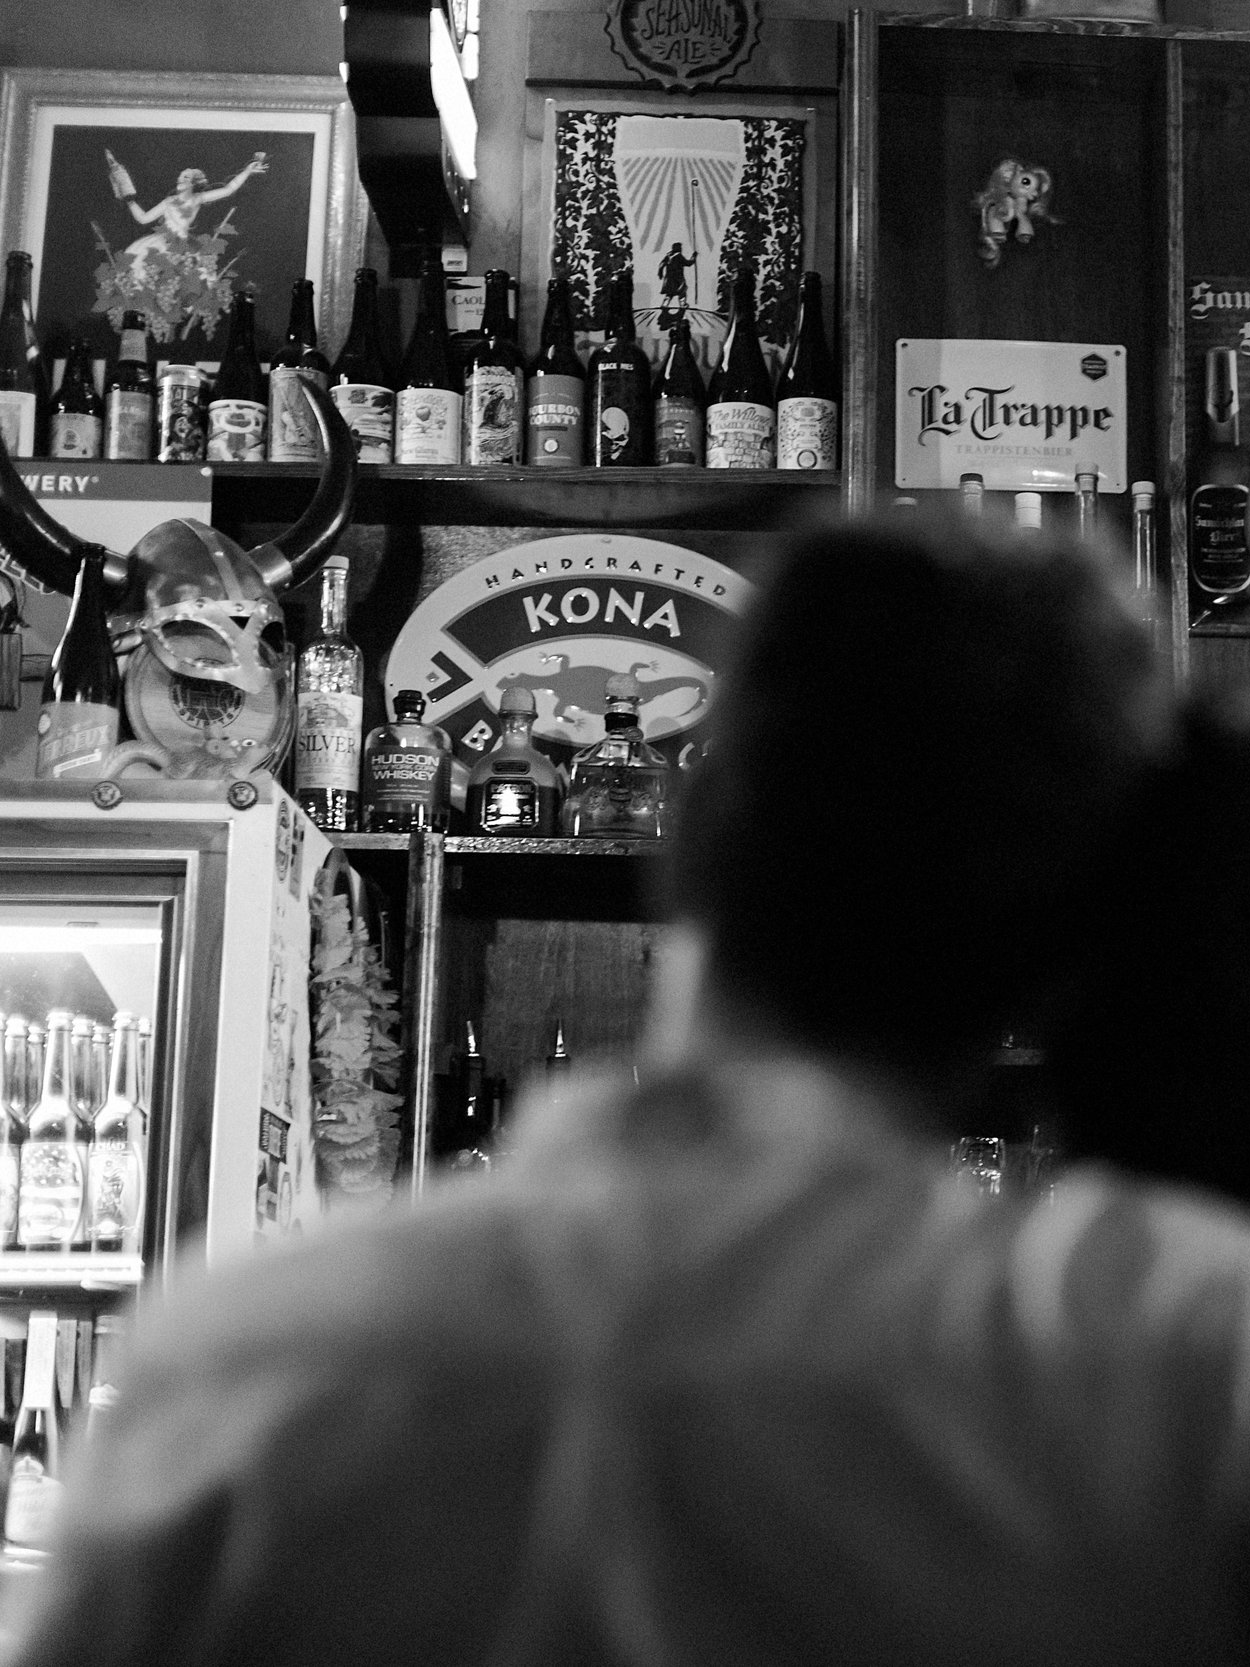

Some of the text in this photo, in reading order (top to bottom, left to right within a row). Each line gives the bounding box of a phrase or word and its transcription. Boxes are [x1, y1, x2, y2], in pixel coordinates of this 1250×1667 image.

[664, 38, 706, 64] ALE
[529, 414, 578, 426] COUNTY
[907, 384, 1115, 447] La Trappe
[955, 444, 1073, 457] TRAPPISTENBIER
[484, 555, 727, 598] HANDCRAFTED
[522, 586, 682, 638] KONA
[298, 734, 356, 754] SILVER
[371, 753, 440, 767] HUDSON
[372, 769, 436, 782] WHISKEY
